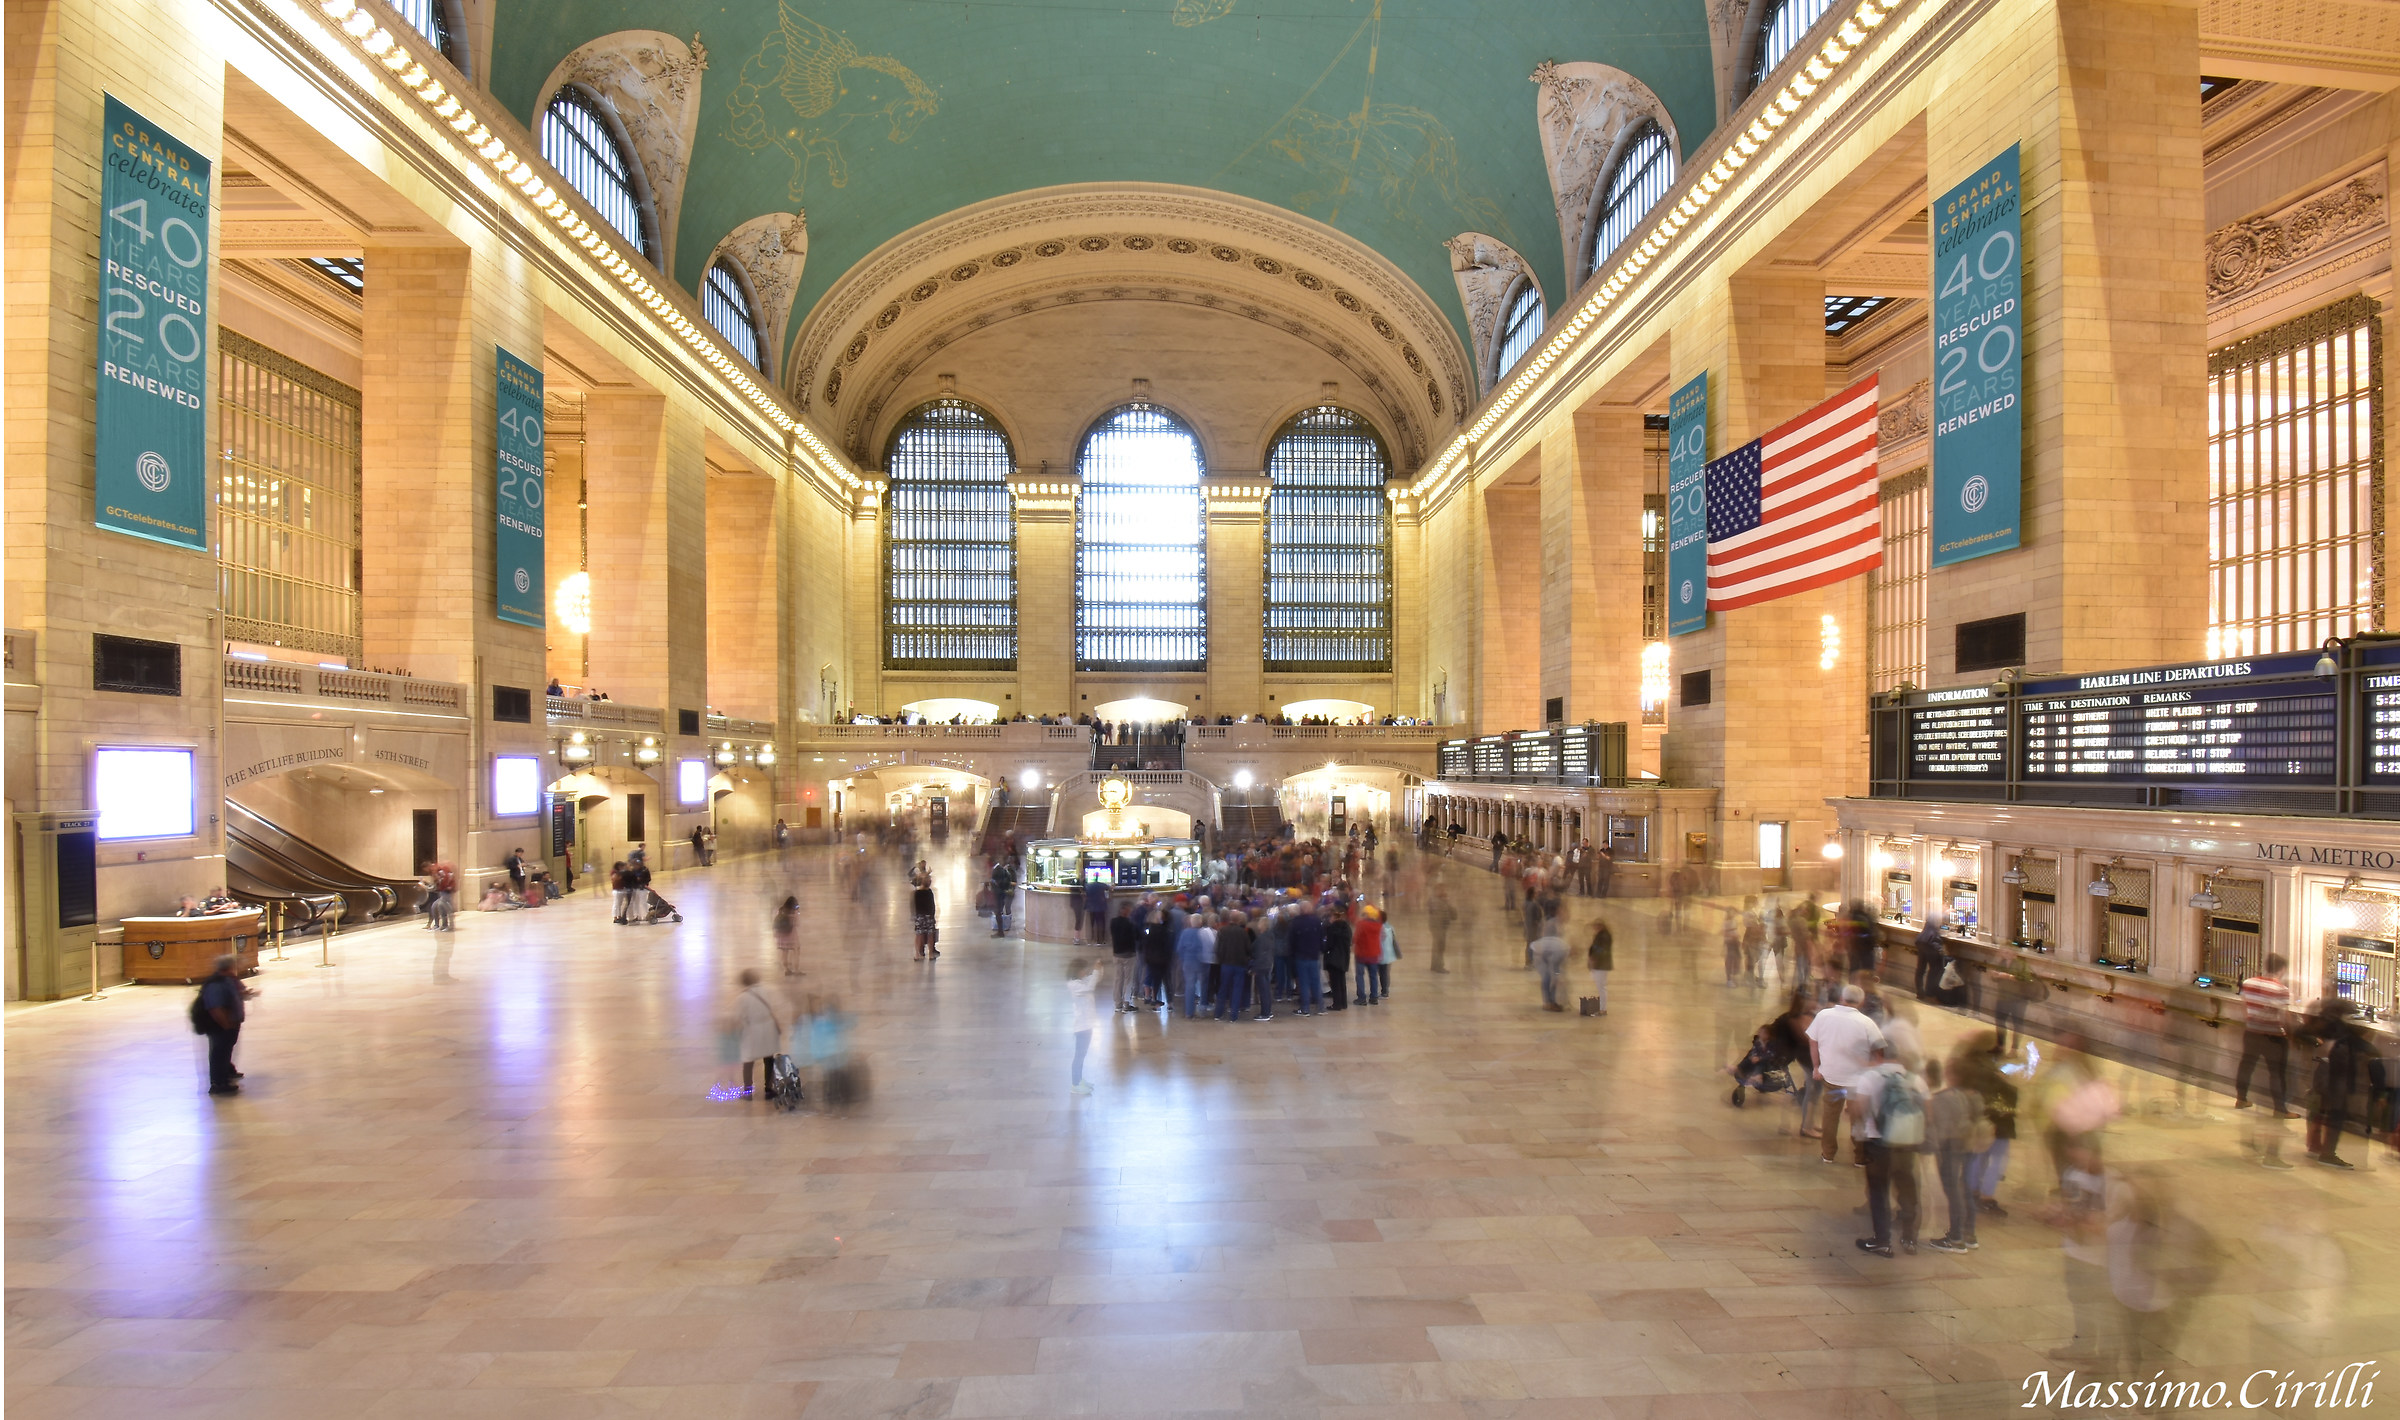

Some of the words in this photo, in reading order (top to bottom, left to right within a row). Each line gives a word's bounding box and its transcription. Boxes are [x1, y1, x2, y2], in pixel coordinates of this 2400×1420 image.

[123, 122, 190, 171] GRAND
[113, 134, 202, 196] CENTRAL
[108, 152, 206, 218] celebrates
[1948, 171, 2001, 214] GRAND
[1940, 180, 2013, 235] CENTRAL
[109, 199, 202, 267] 40
[1937, 193, 2016, 258] celebrates
[109, 232, 201, 296] YEARS
[1939, 230, 2014, 300] 40
[107, 259, 201, 315] RESCUED
[1940, 274, 2014, 329] YEARS
[107, 288, 200, 362] 20
[1939, 298, 2015, 349] RESCUED
[106, 334, 199, 390] YEARS
[504, 360, 535, 384] GRAND
[1939, 324, 2015, 396] 20
[104, 361, 200, 410] RENEWED
[499, 380, 542, 414] celebrates
[500, 369, 540, 398] CENTRAL
[1675, 385, 1700, 407] GRAND
[1939, 368, 2015, 417] YEARS
[1672, 393, 1704, 420] CENTRAL
[1938, 393, 2015, 436] RENEWED
[500, 407, 541, 447] 40
[1670, 424, 1704, 462] 40
[499, 450, 542, 477] RESCUED
[500, 432, 541, 464] YEARS
[500, 466, 542, 508] 20
[1670, 469, 1704, 494] RESCUED
[106, 505, 197, 535] GCTcelebrates.com
[500, 499, 542, 526] YEARS
[1671, 485, 1705, 525] 20
[500, 514, 542, 538] RENEWED
[1671, 530, 1704, 552] RENEWED
[1939, 527, 2012, 553] GCTcelebrates.com
[2080, 674, 2130, 689] HARLEM
[2133, 671, 2162, 684] LINE
[2165, 662, 2252, 682] DEPARTURES
[2367, 675, 2400, 688] TIME
[1928, 688, 1989, 702] INFORMATION
[2024, 702, 2044, 711] TIME
[2048, 701, 2066, 710] TRK
[2071, 696, 2130, 708] DESTINATION
[2143, 691, 2192, 704] REMARKS
[2029, 715, 2045, 724] 4:10
[2055, 714, 2066, 722] 111
[2146, 708, 2169, 718] WHITE
[2172, 706, 2202, 717] PLAINS
[2217, 704, 2232, 714] 1ST
[2235, 703, 2258, 713] STOP
[2192, 720, 2206, 730] 1ST
[2210, 719, 2232, 729] STOP
[2029, 752, 2045, 760] 4:42
[2192, 749, 2206, 758] 1ST
[2210, 748, 2232, 758] STOP
[2201, 734, 2217, 744] 1ST
[2220, 733, 2241, 743] STOP
[225, 769, 247, 787] THE
[248, 754, 294, 777] METLIFE
[296, 747, 344, 764] BUILDING
[374, 750, 397, 762] 45TH
[398, 754, 430, 769] STREET
[2028, 764, 2045, 773] 5:10
[2145, 763, 2192, 773] CONNECTION
[2196, 763, 2206, 772] TO
[2257, 843, 2302, 861] MTA
